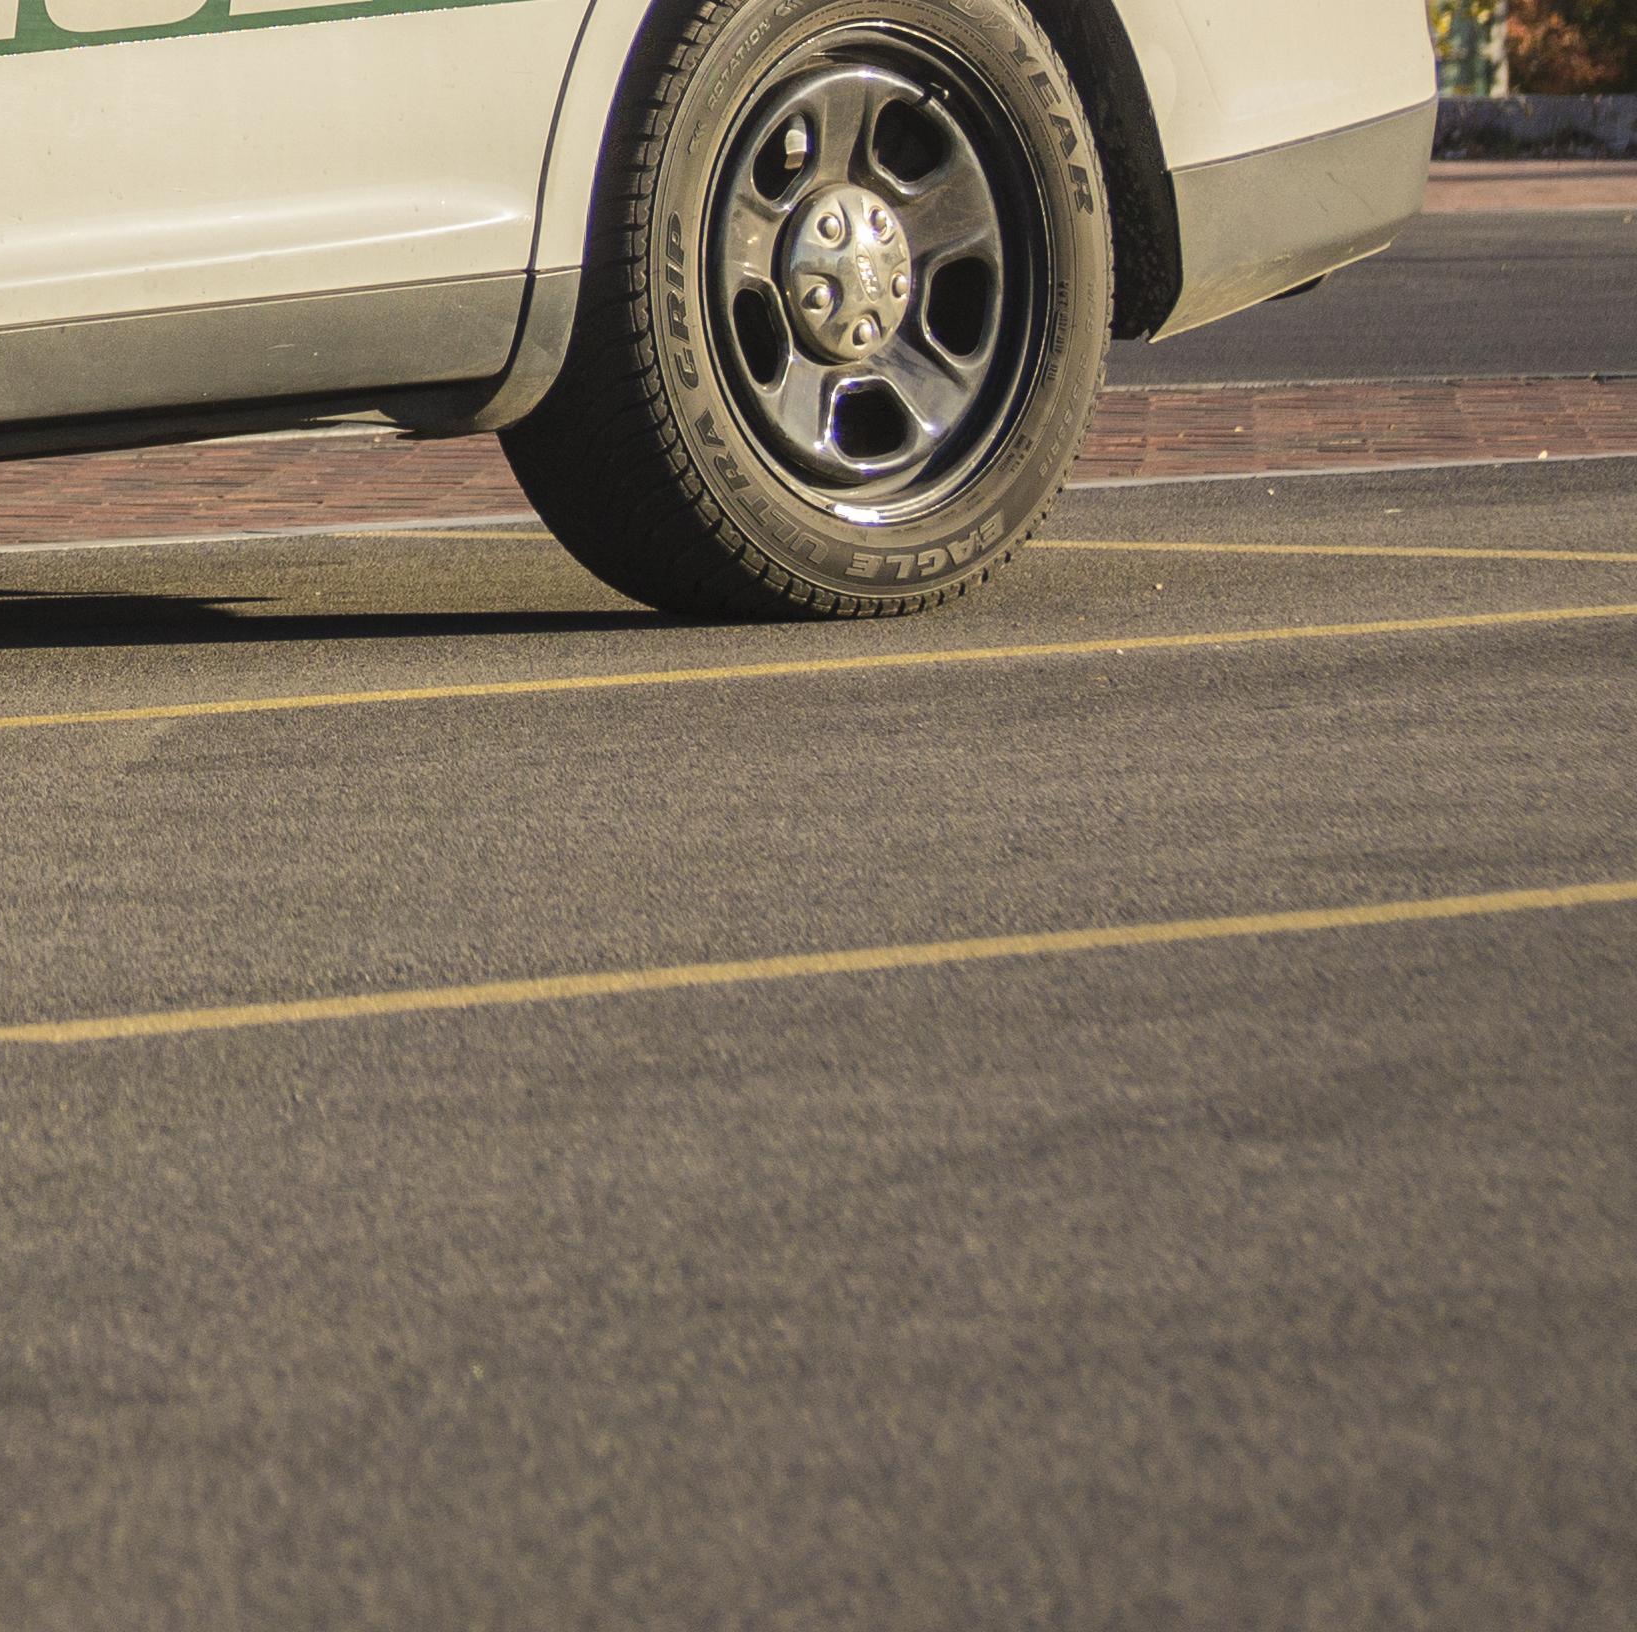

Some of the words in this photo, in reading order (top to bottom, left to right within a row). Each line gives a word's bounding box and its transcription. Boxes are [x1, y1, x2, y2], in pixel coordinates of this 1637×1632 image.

[707, 17, 772, 112] ROTATION
[664, 210, 701, 392] GRIP
[693, 407, 829, 567] ULTRA
[844, 509, 1006, 581] EAGLE
